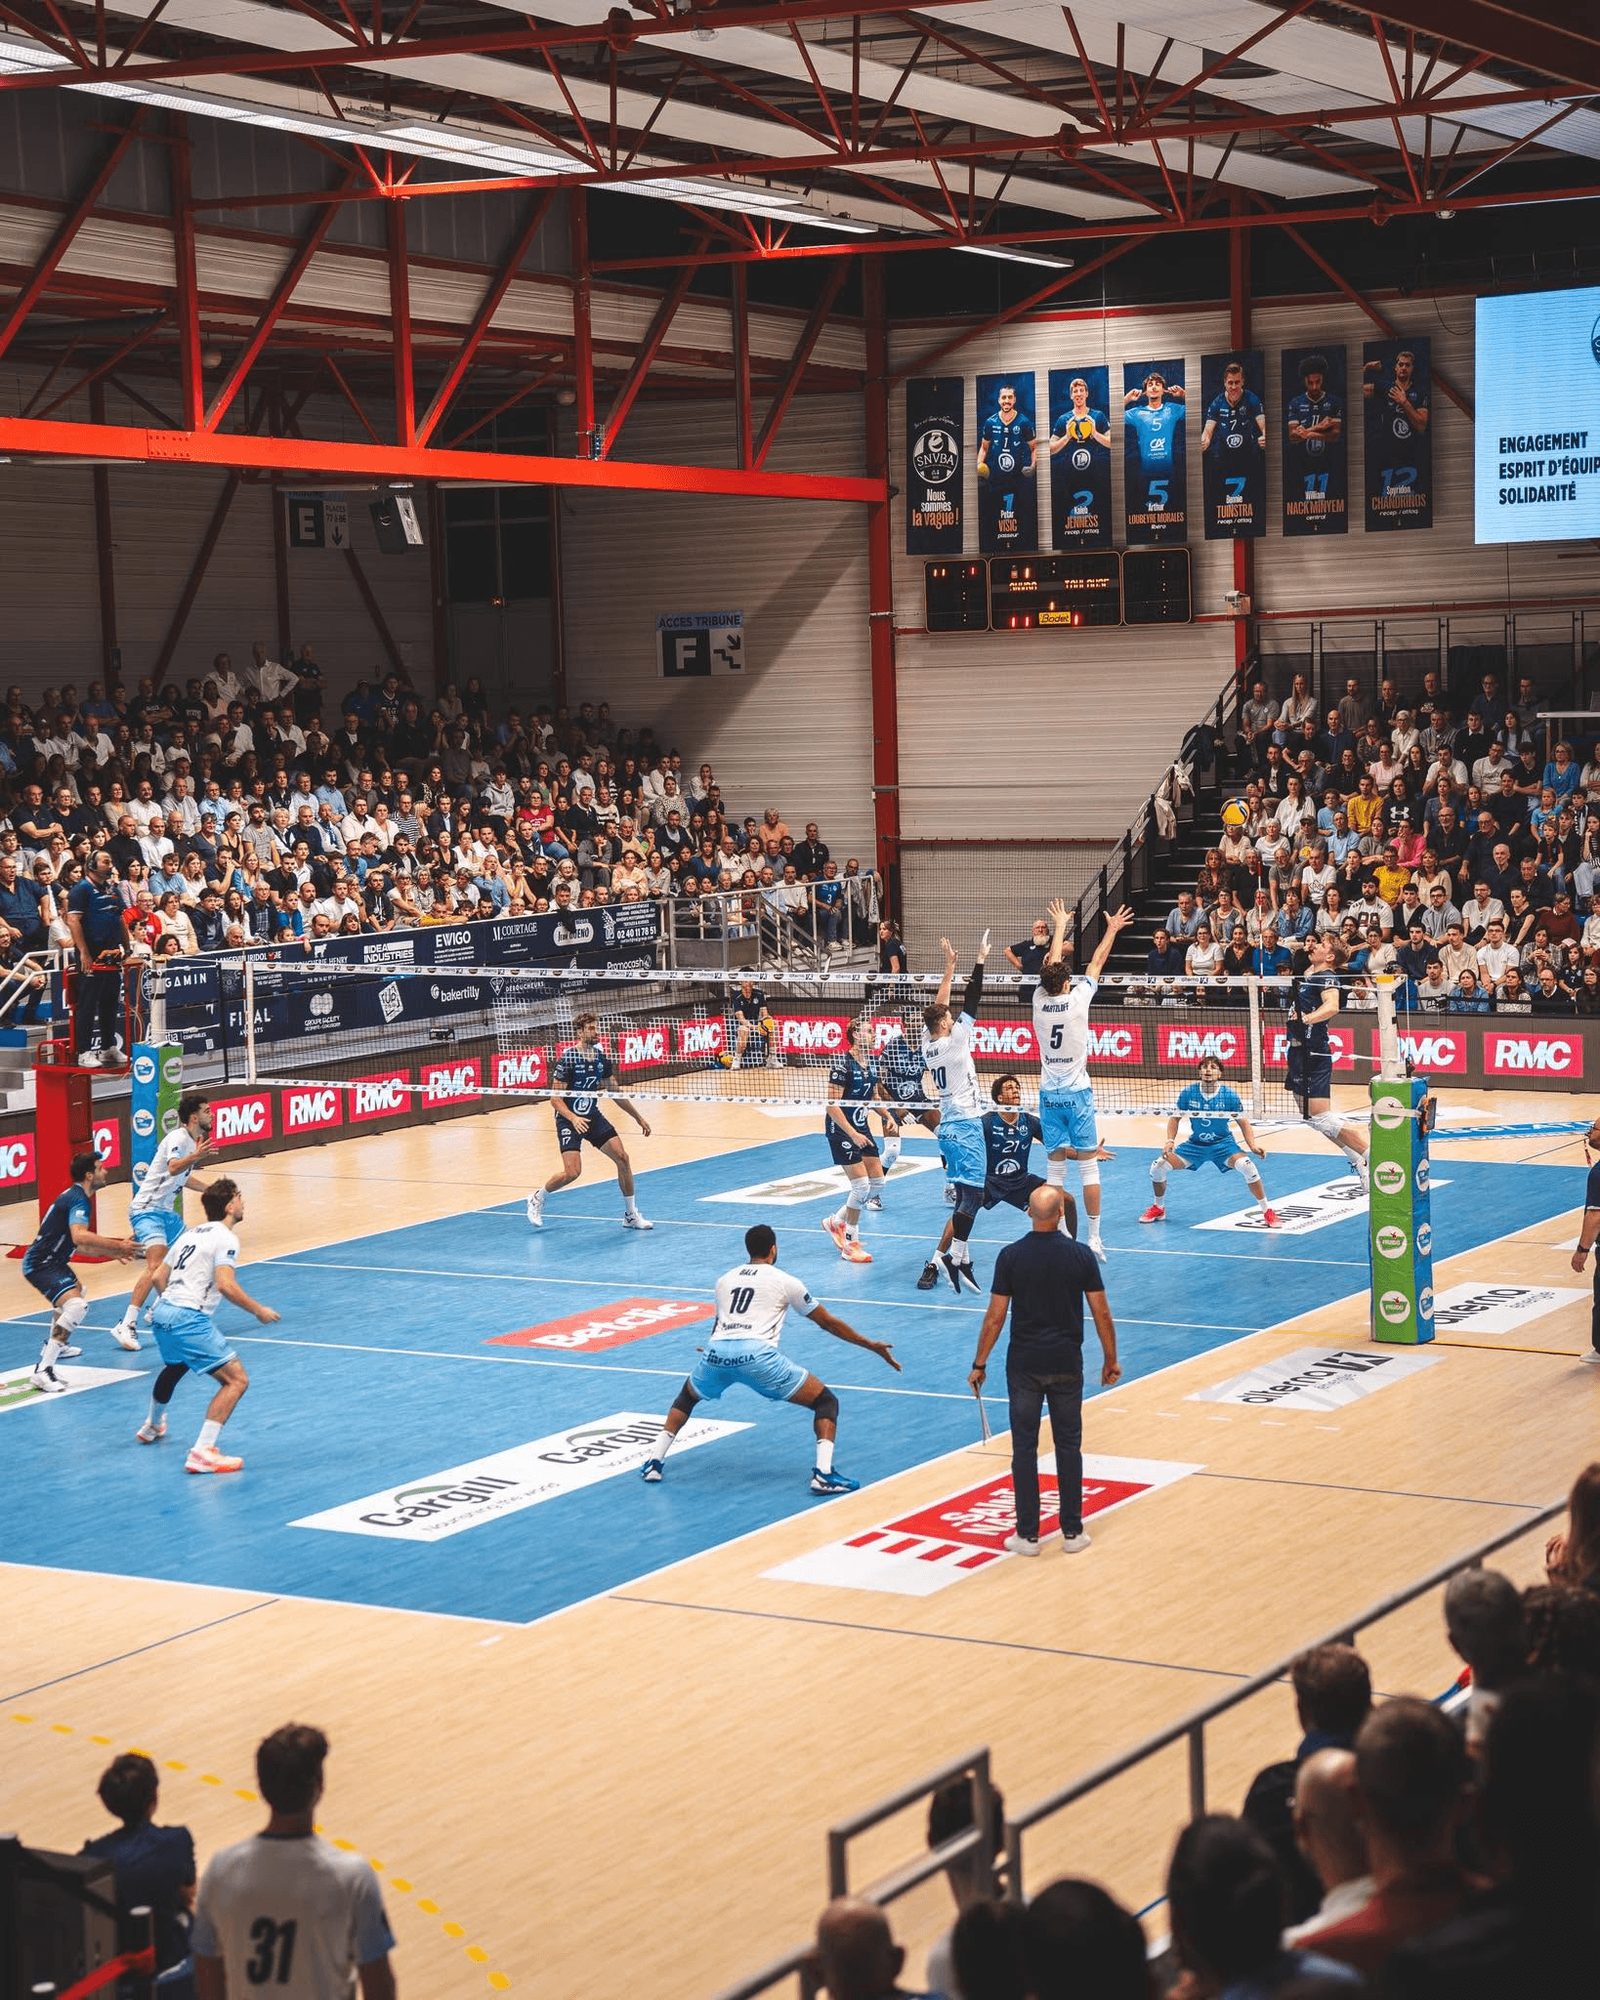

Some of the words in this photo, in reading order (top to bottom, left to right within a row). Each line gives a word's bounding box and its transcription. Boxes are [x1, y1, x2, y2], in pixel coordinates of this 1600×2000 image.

[1151, 418, 1162, 432] 5
[1230, 419, 1238, 431] 7
[1499, 431, 1589, 455] ENGAGEMENT
[916, 453, 955, 468] SNVBA
[1499, 460, 1546, 480] ESPRIT
[926, 488, 946, 502] Nous
[1145, 480, 1169, 506] 5
[1225, 477, 1247, 497] 7
[1499, 481, 1577, 505] SOLIDARITÉ
[920, 501, 952, 513] sommes
[1003, 493, 1014, 511] 1
[1067, 490, 1094, 515] 2
[1216, 503, 1254, 519] TUINSTRA
[1286, 501, 1308, 516] NACK
[1308, 499, 1345, 513] MINYEM
[298, 507, 316, 541] E
[912, 509, 923, 527] la
[925, 509, 955, 530] vague
[658, 616, 693, 629] ACCES
[693, 614, 741, 627] TRIBUNE
[1041, 613, 1070, 624] Bodet
[675, 637, 697, 670] F
[435, 930, 472, 948] EWIGO
[501, 921, 538, 937] COURTAGE
[616, 929, 626, 940] 02
[625, 928, 635, 939] 40
[363, 949, 415, 964] INDUSTRIES
[606, 956, 645, 970] Promocash
[440, 986, 480, 1002] bakertilly
[229, 1007, 271, 1028] FIAL
[683, 1021, 721, 1052] RMC
[782, 1020, 842, 1048] RMC
[969, 1026, 1032, 1054] RMC
[1049, 1024, 1065, 1050] 5
[1167, 1030, 1236, 1060] RMC
[625, 1032, 664, 1064] RMC
[1273, 1033, 1344, 1063] RC
[1495, 1039, 1573, 1071] RMC
[498, 1053, 541, 1088] RMC
[428, 1065, 475, 1100] RMC
[582, 1075, 598, 1089] 17
[863, 1082, 871, 1097] 7
[355, 1078, 403, 1115] RMC
[289, 1090, 336, 1126] RMC
[215, 1101, 265, 1140] RMC
[562, 1136, 571, 1146] 17
[1001, 1140, 1021, 1154] 21
[846, 1151, 853, 1161] 7
[173, 1244, 197, 1270] 32
[729, 1286, 755, 1315] 10
[528, 1302, 700, 1348] Betclic
[718, 1353, 756, 1367] FONCIA
[1241, 1370, 1338, 1404] alterna
[537, 1421, 665, 1465] Cargill
[359, 1476, 521, 1527] Cargill
[247, 1915, 298, 1986] 31
